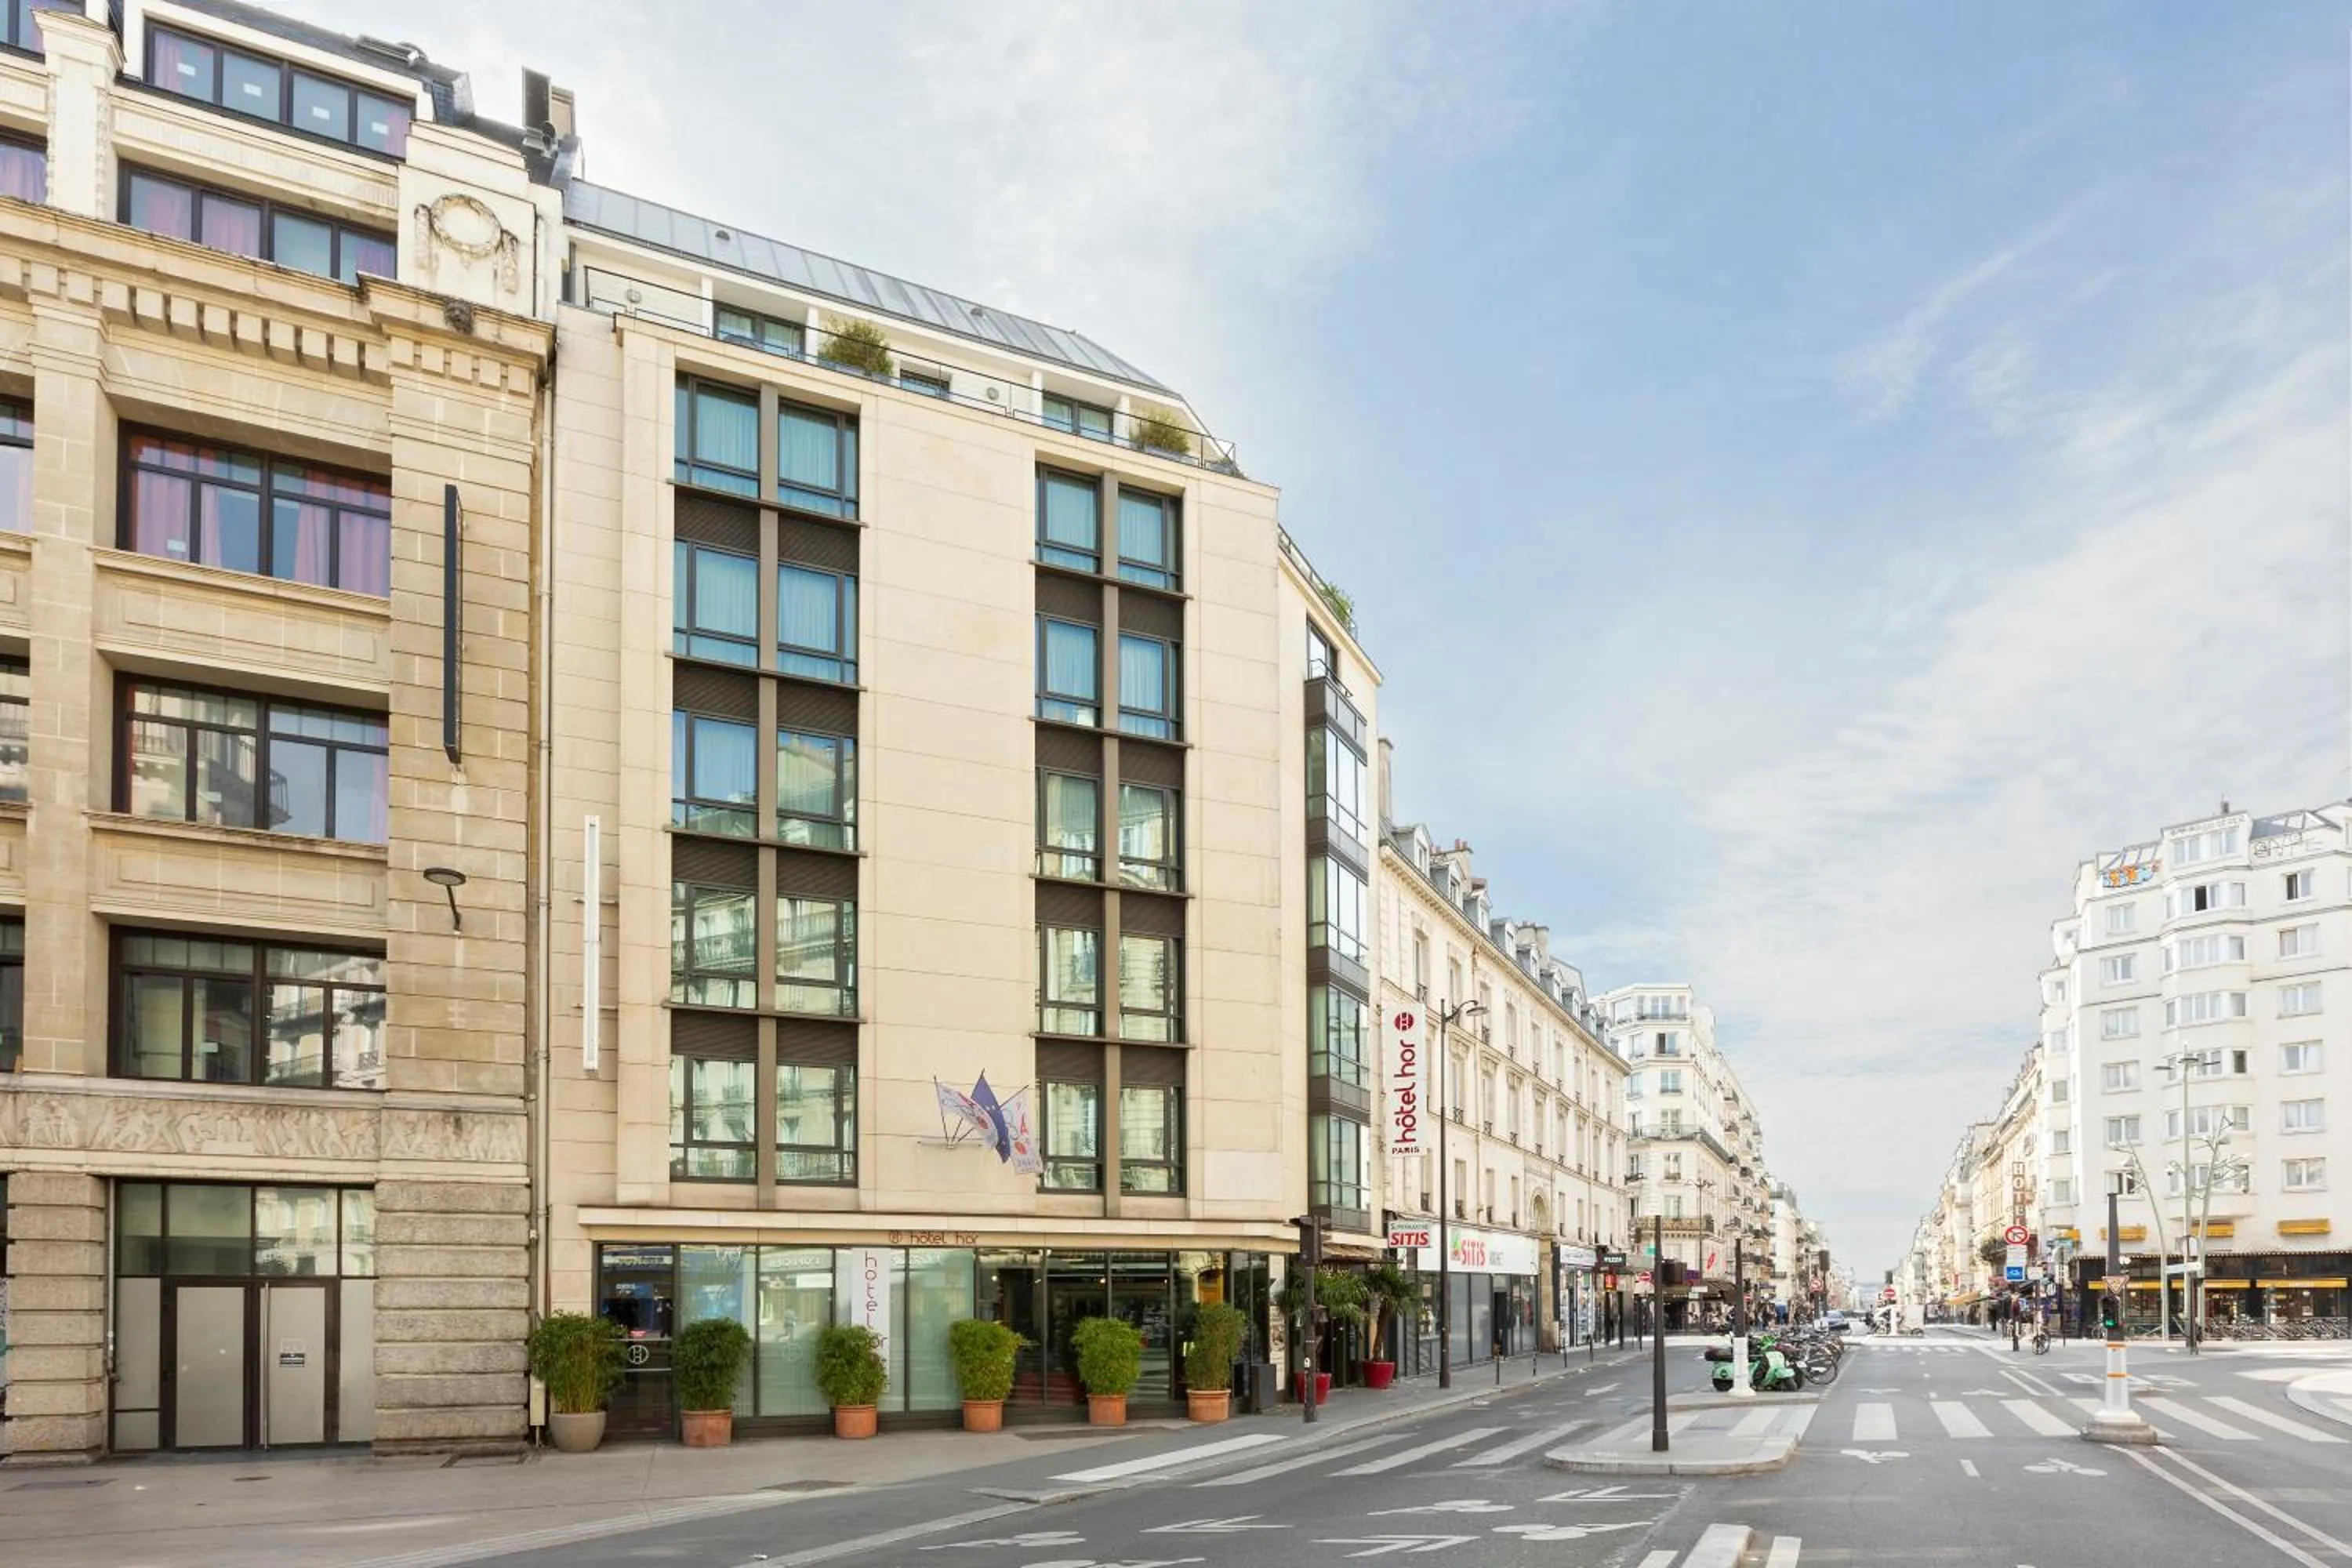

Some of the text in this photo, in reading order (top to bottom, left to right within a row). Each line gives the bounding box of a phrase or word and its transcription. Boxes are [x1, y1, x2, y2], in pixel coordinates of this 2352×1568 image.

[1394, 1040, 1416, 1143] hôtel hor
[1390, 1232, 1429, 1246] SITIS
